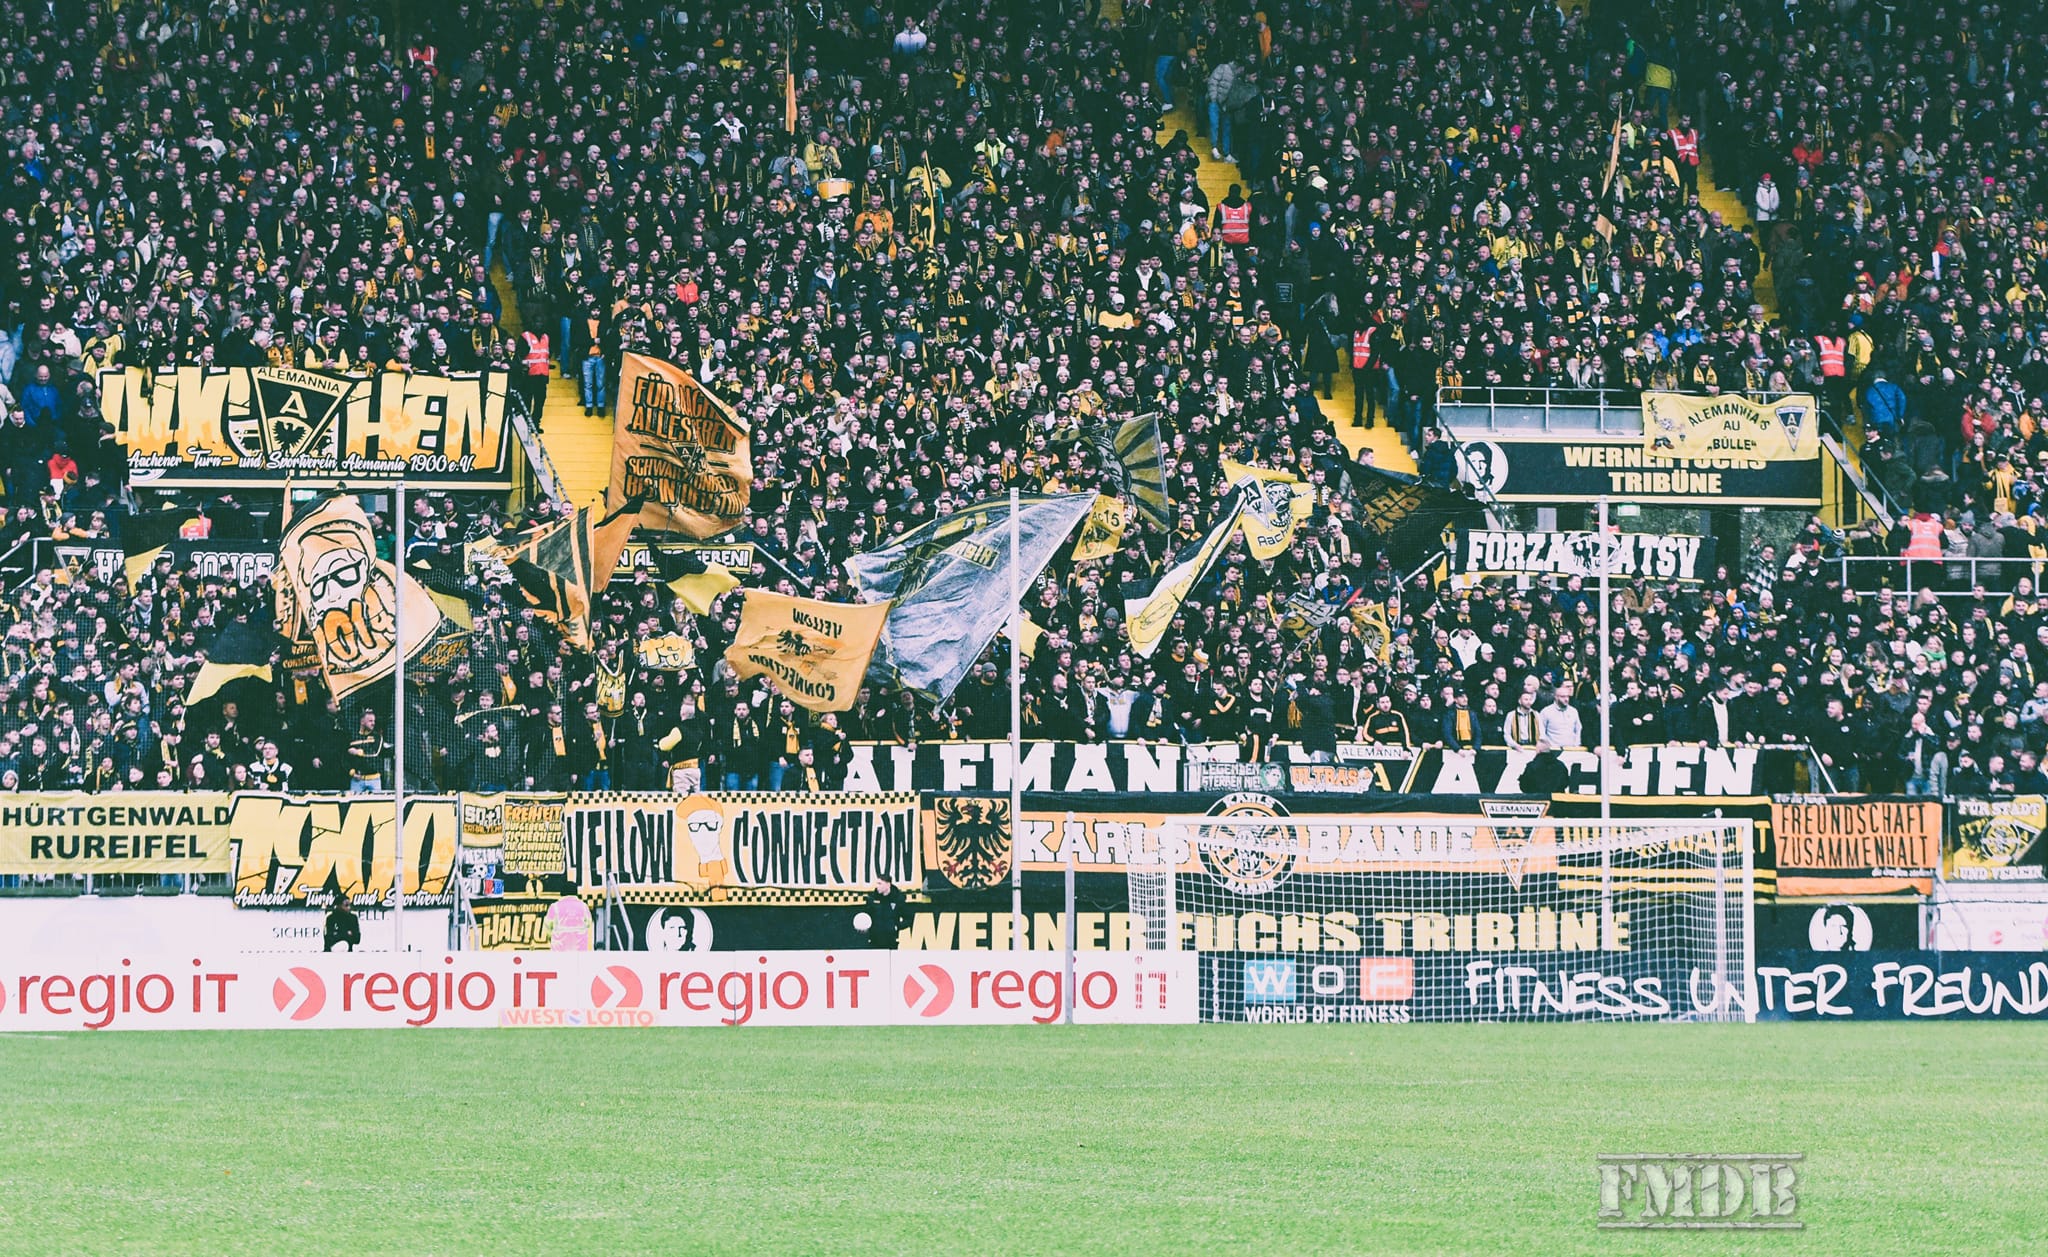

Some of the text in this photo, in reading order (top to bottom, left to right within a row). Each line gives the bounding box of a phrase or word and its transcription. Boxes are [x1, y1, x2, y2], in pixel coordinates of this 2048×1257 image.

[257, 366, 342, 393] ALEMANNIA
[630, 406, 694, 443] ALLES
[1723, 419, 1741, 432] AU
[126, 449, 183, 470] Aachener
[239, 452, 264, 470] und
[266, 450, 338, 473] Sportverein
[341, 452, 406, 473] Alemannia
[409, 453, 448, 472] 1900
[449, 453, 475, 473] e.V.
[1563, 446, 1674, 469] WERNER
[1608, 470, 1723, 494] TRIBÜNE
[1466, 532, 1700, 578] FORZA ATSV
[1341, 747, 1402, 758] ALEMANN
[1202, 763, 1260, 776] LEGENDEN
[1291, 766, 1359, 786] ULTRAS
[2, 805, 230, 828] HÜRTGENWALD
[504, 804, 562, 822] FREIHEIT
[1488, 803, 1541, 814] ALEMANNIA
[1781, 803, 1926, 836] FREUNDSCHAFT
[30, 833, 207, 860] RUREIFEL
[566, 808, 673, 886] YELLOW
[733, 808, 915, 885] CONNECTION
[1017, 819, 1478, 865] KARLS BANDE
[1778, 835, 1929, 867] ZUSAMMENHALT
[233, 884, 293, 907] Aachener
[353, 889, 378, 906] und
[898, 906, 1631, 952] WERNER FUCHS TRIBÜNE
[18, 958, 238, 1030] regio iT
[343, 956, 558, 1026] regio iT
[659, 955, 870, 1026] regio iT
[970, 955, 1118, 1024] regio
[1134, 955, 1167, 1009] iT
[1464, 960, 1669, 1015] FITNESS
[1690, 962, 1853, 1015] UNTER
[507, 1009, 654, 1027] WEST LOTTO
[1245, 1005, 1410, 1024] WORLD OF FITNESS
